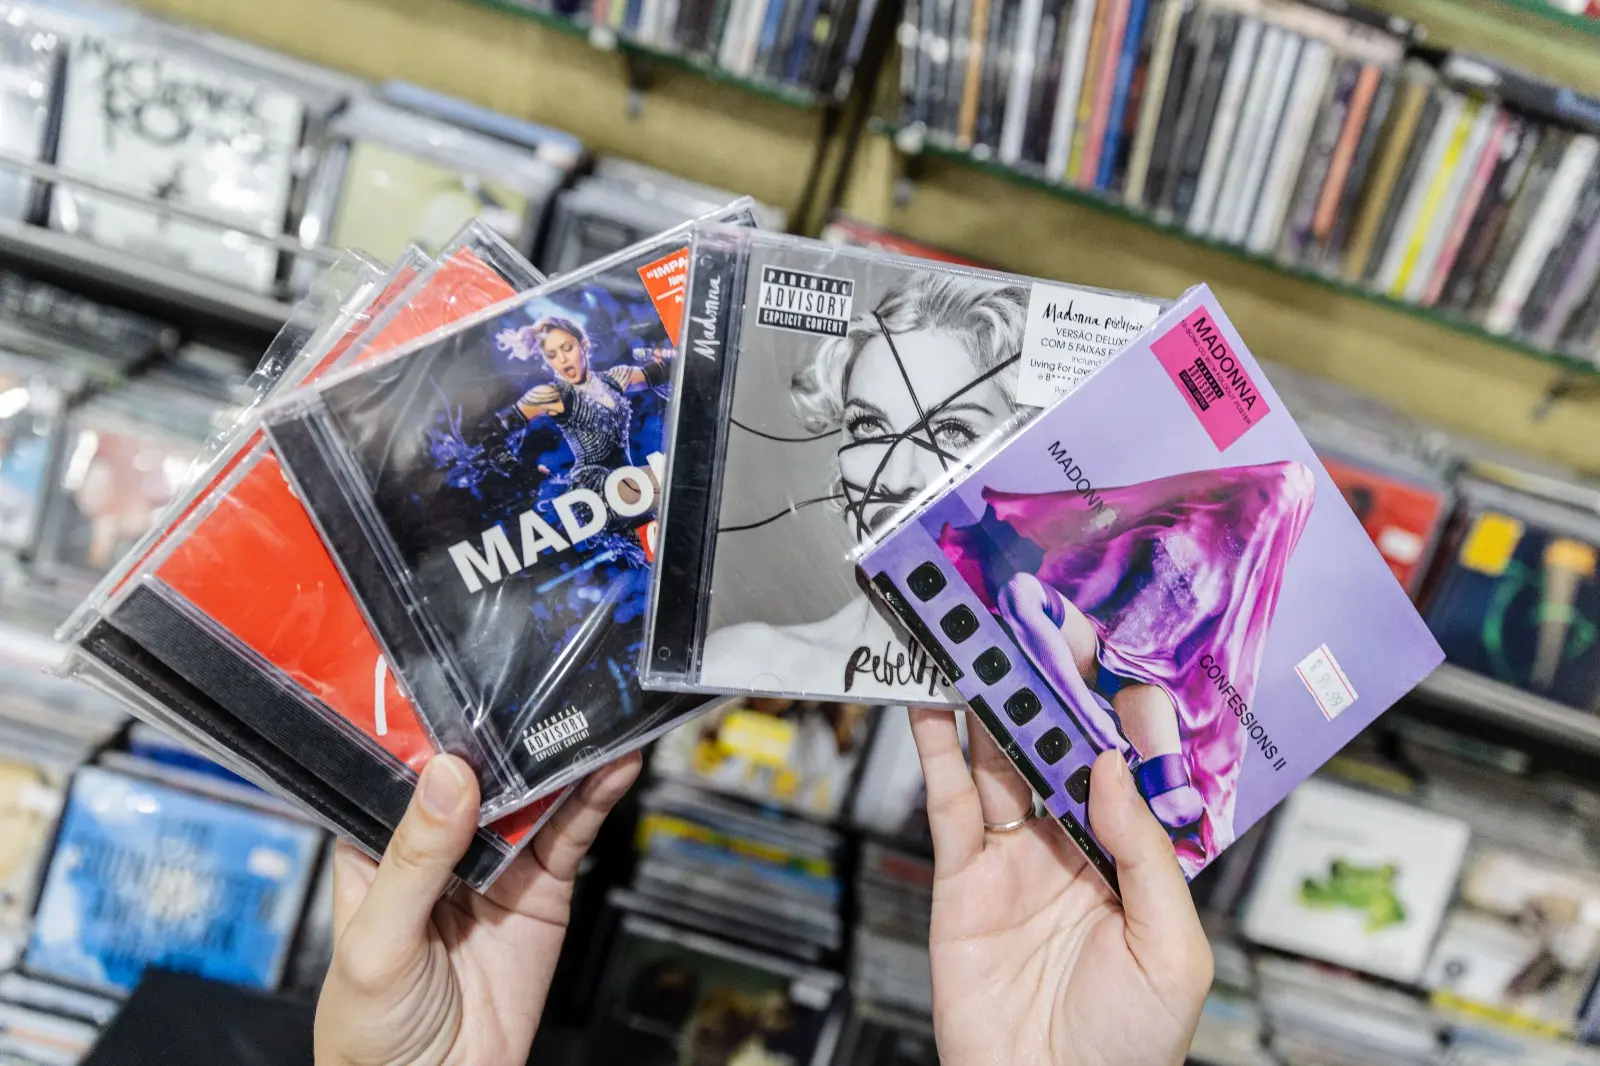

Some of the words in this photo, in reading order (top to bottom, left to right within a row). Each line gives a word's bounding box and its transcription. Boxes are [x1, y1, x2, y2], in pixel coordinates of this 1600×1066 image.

[768, 271, 848, 295] PARENTAL
[764, 285, 847, 317] ADVISORY
[1042, 300, 1101, 327] Madonna
[690, 275, 721, 362] Madonna
[763, 309, 803, 328] EXPLICIT
[805, 317, 844, 334] CONTENT
[1040, 338, 1066, 350] COM
[1067, 342, 1075, 351] 5
[1075, 343, 1106, 357] FAIXAS
[1056, 327, 1093, 343] VERSÃO
[1030, 358, 1056, 372] Living
[1057, 363, 1072, 373] For
[1193, 316, 1257, 411] MADONNA
[1187, 364, 1217, 403] ADVISORY
[1233, 400, 1252, 425] POSTER
[522, 705, 578, 738] PARENTAL
[1200, 654, 1278, 760] CONFESSIONS
[1272, 757, 1287, 772] II
[527, 714, 586, 753] ADVISORY
[535, 743, 563, 762] EXPLICIT
[563, 729, 590, 748] CONTENT
